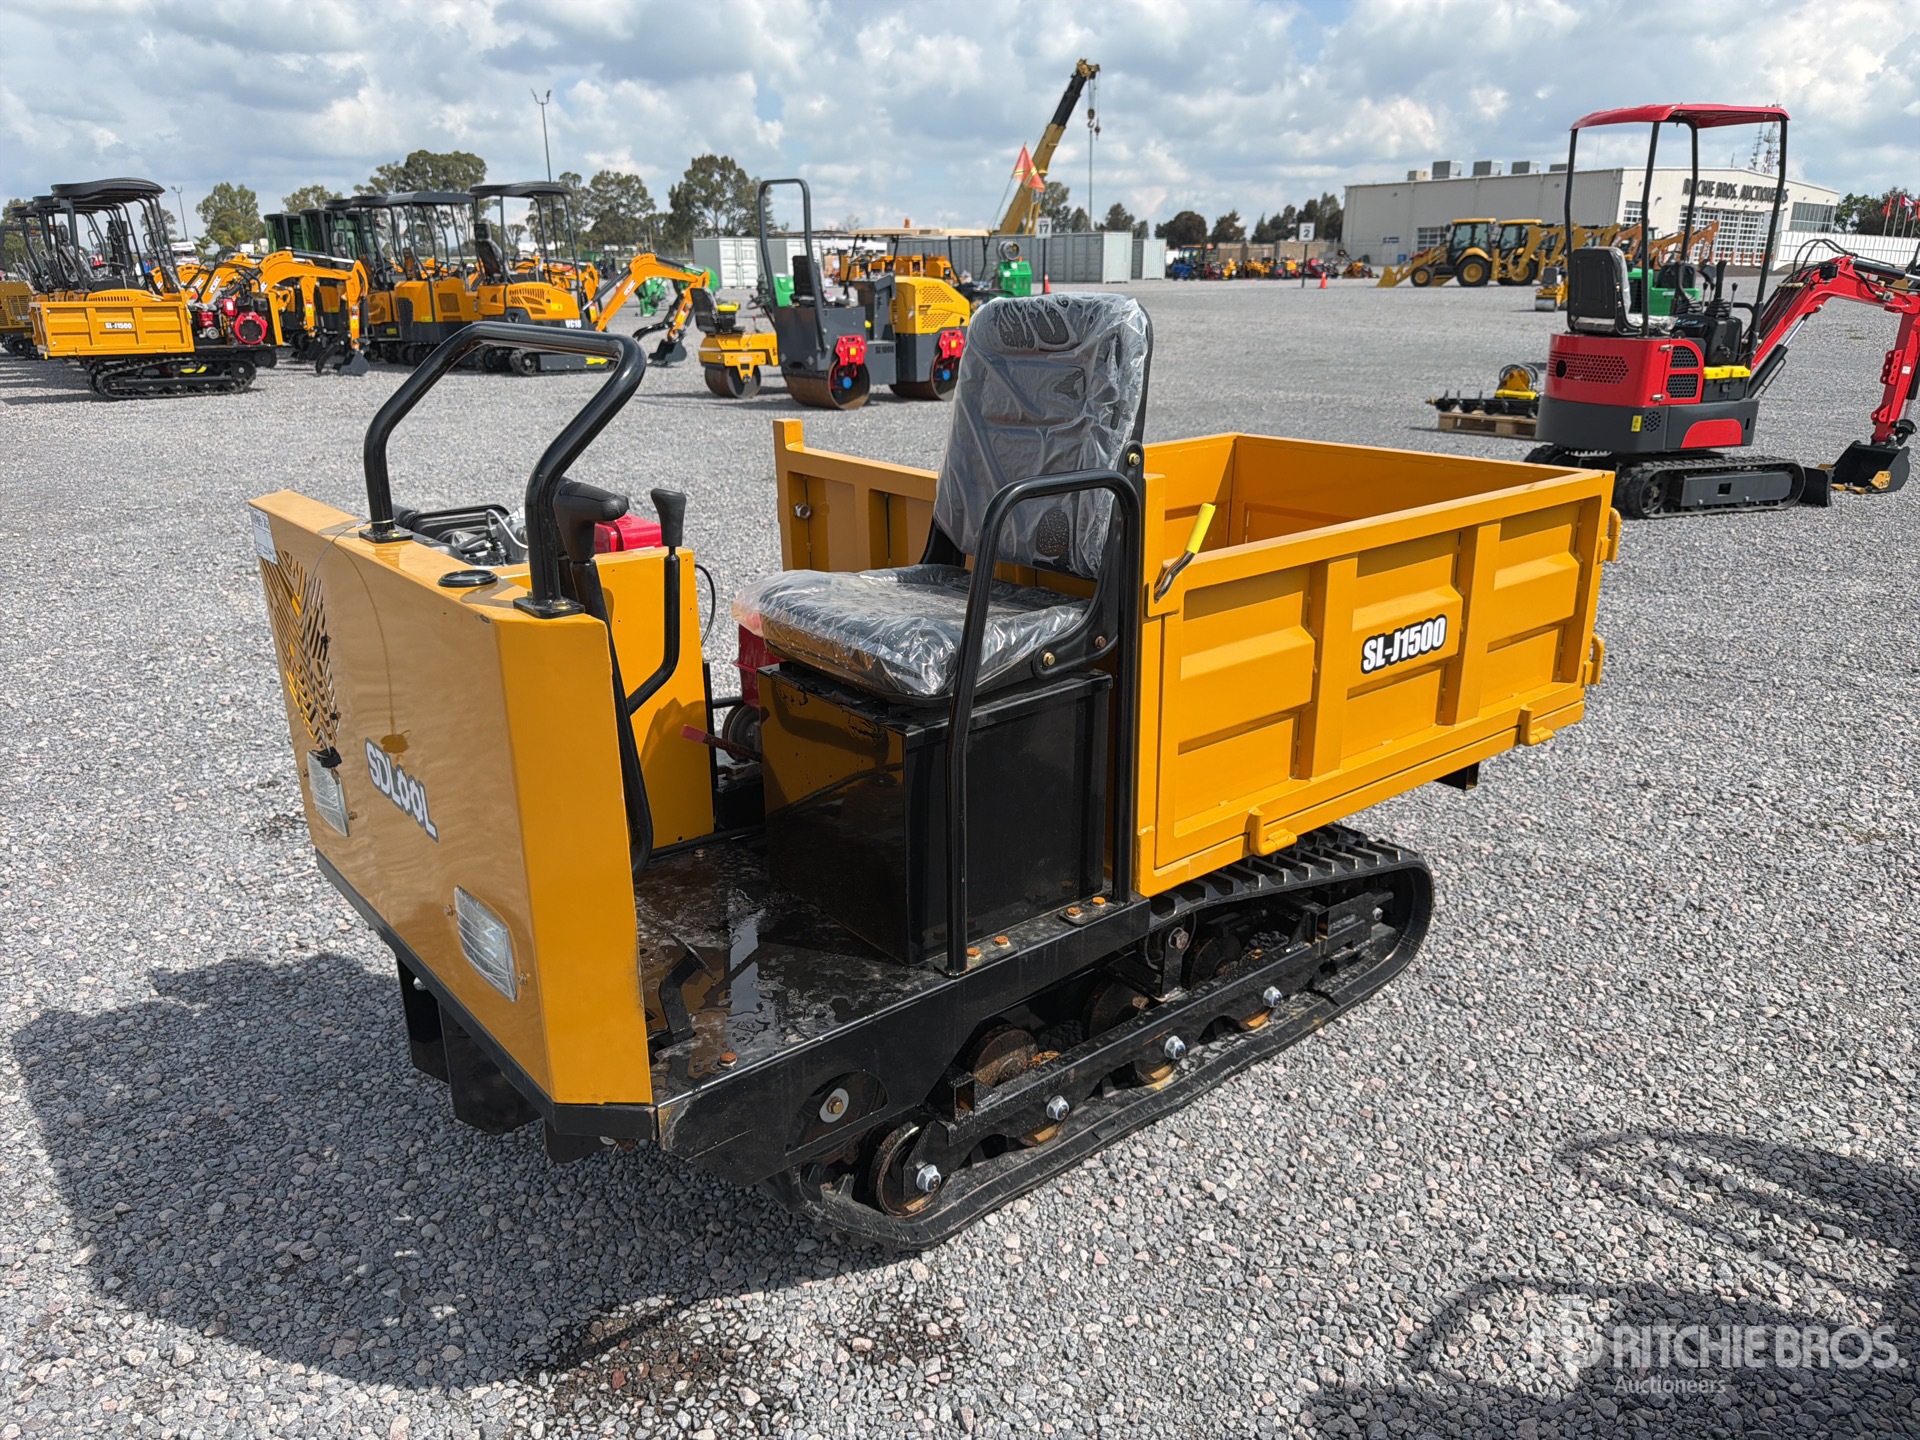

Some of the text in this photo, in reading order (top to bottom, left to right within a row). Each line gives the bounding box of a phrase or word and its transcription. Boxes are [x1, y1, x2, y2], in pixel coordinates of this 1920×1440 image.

[1682, 178, 1716, 198] RCHIE
[1738, 185, 1789, 204] AUCTIONES
[1039, 223, 1049, 234] 17
[1303, 229, 1311, 238] 2
[1362, 616, 1447, 672] SL-J1500
